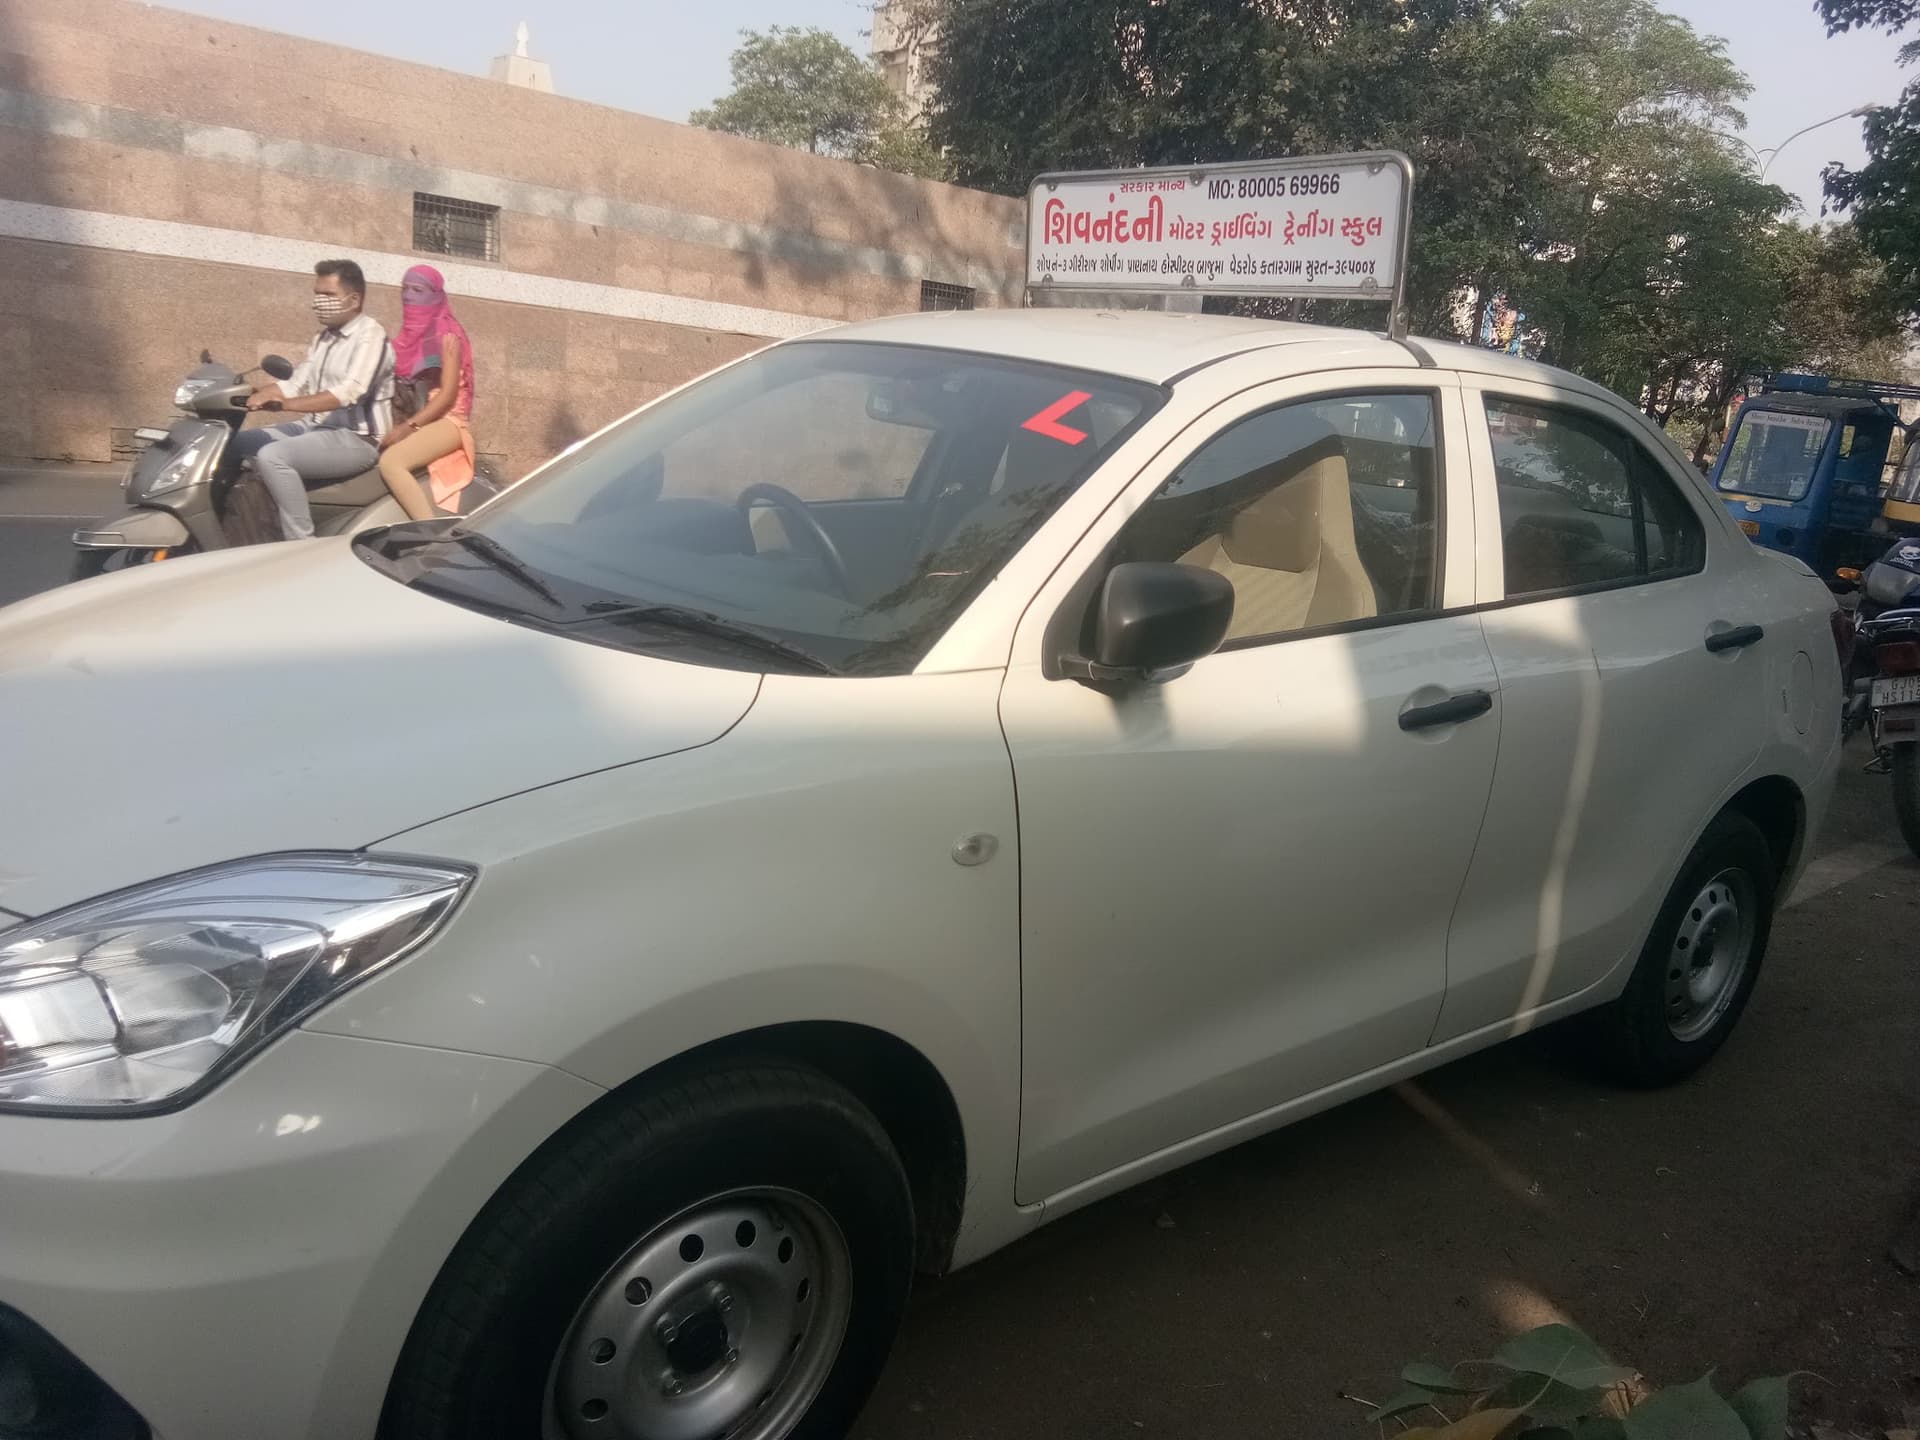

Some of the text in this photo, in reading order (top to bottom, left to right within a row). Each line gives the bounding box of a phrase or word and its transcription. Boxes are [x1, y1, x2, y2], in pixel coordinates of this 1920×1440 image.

[1120, 180, 1185, 192] સરકાર માન્ય
[1208, 174, 1340, 200] MO: 80005 69966
[1044, 192, 1163, 244] શિવનંદની
[1169, 215, 1205, 240] મોટર
[1260, 260, 1302, 275] કતારગામ
